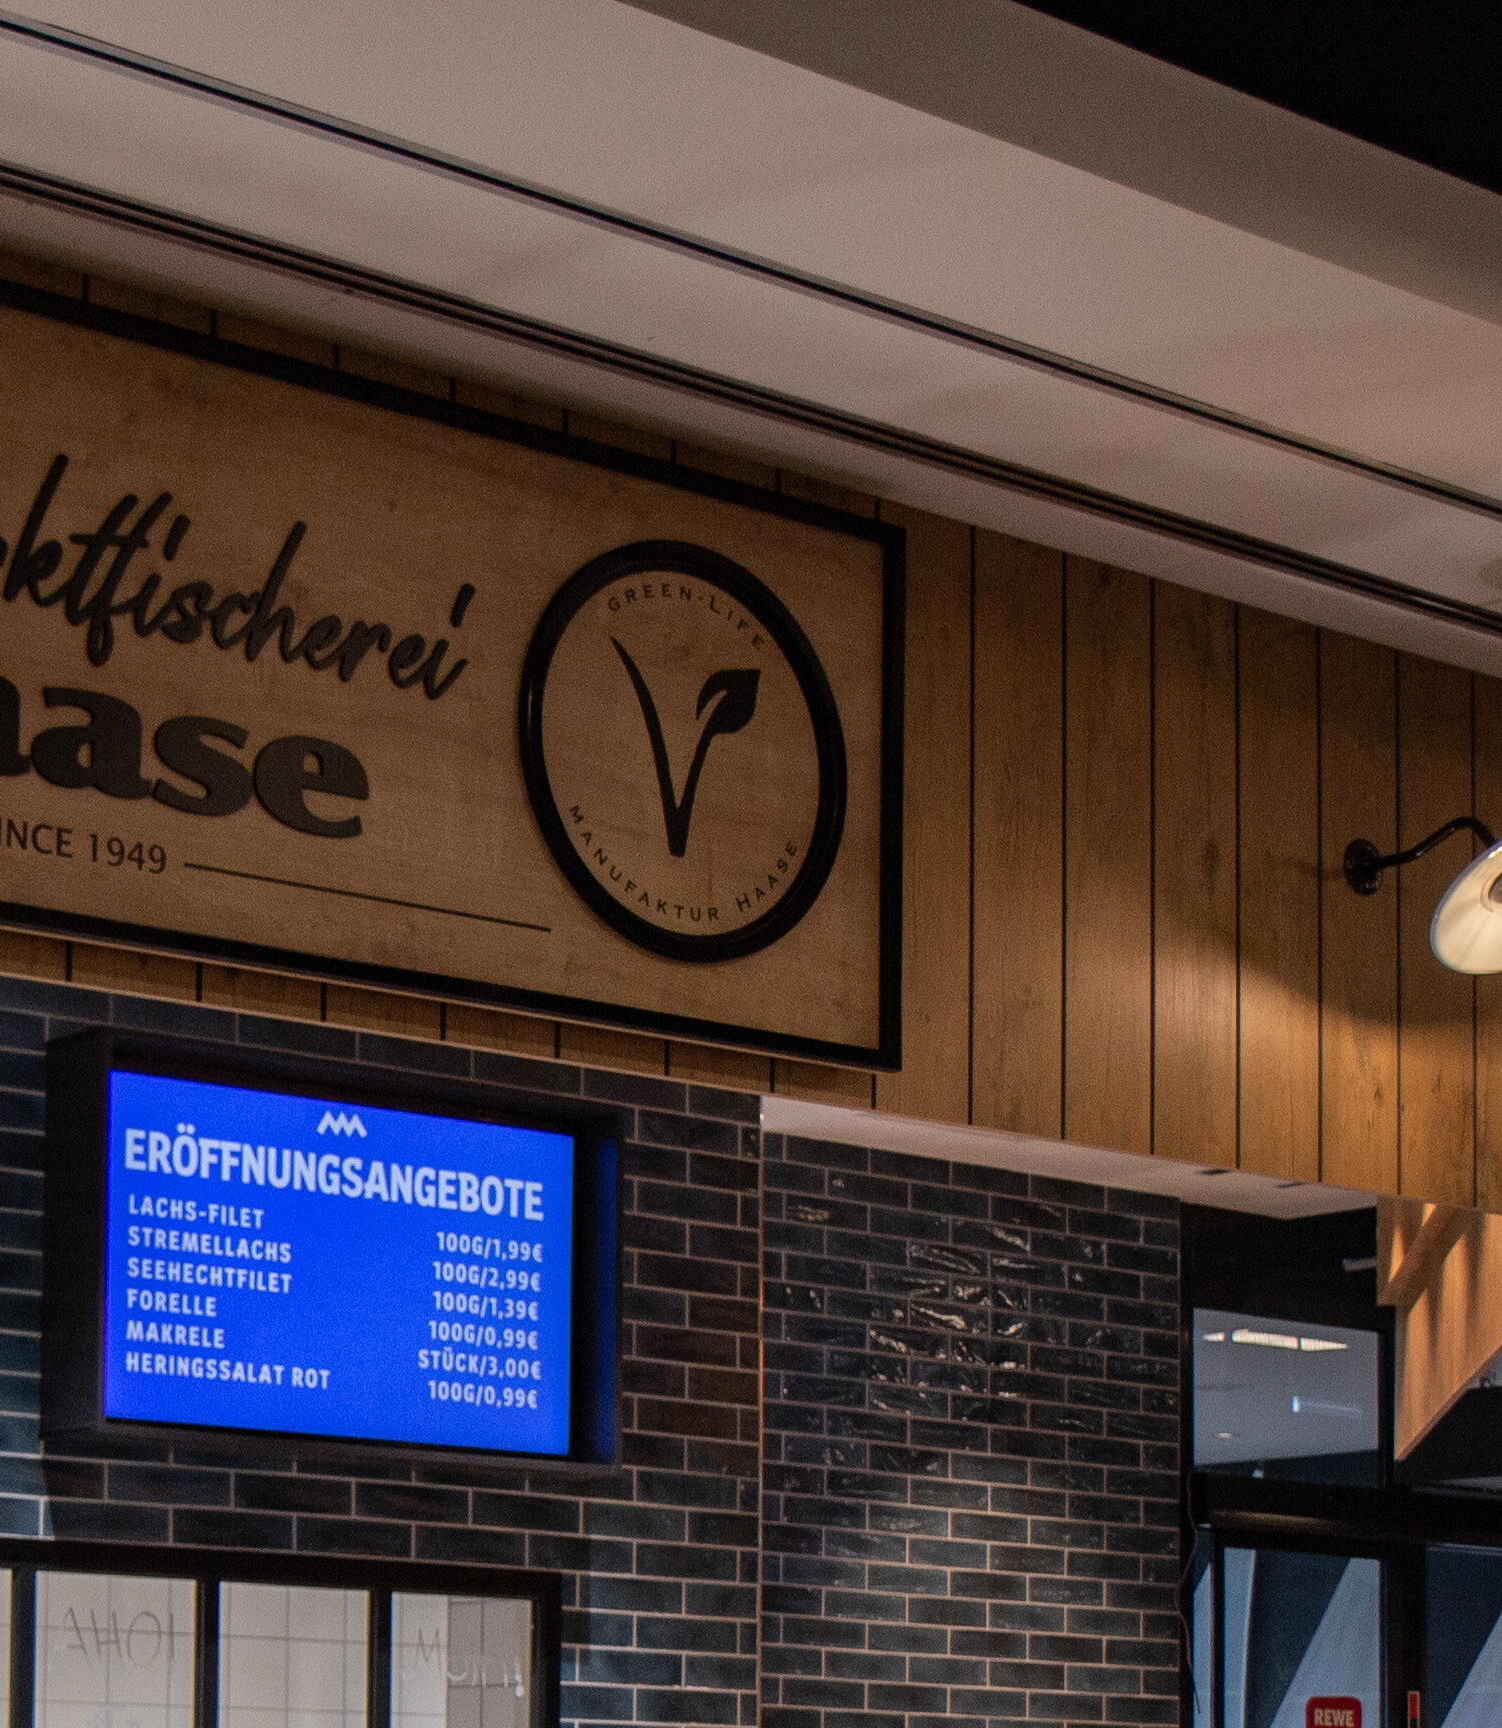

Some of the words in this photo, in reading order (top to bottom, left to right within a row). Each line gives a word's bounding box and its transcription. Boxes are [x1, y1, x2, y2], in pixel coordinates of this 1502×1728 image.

[88, 833, 167, 875] 1949
[569, 805, 720, 922] MANUFAKTUR
[736, 841, 798, 913] HAASE
[124, 1123, 544, 1221] ERÖFFNUNGSANGEBOTE
[128, 1195, 265, 1230] LACHS-FILET
[127, 1226, 292, 1263] STREMELLACHS
[435, 1231, 544, 1263] 100G/1,99€
[127, 1257, 293, 1294] SEEHECHTFILET
[431, 1261, 542, 1293] 100G/2,99€
[126, 1289, 217, 1318] FORELLE
[126, 1320, 226, 1350] MAKRELE
[428, 1320, 539, 1351] 100G/0,99€
[126, 1352, 284, 1386] HERINGSSALAT
[291, 1365, 331, 1390] ROT
[418, 1346, 542, 1382] STÜCK/3,00€
[428, 1379, 538, 1410] 100G/0,99€
[63, 1607, 176, 1668] AHOI
[1314, 1708, 1354, 1728] REWE
